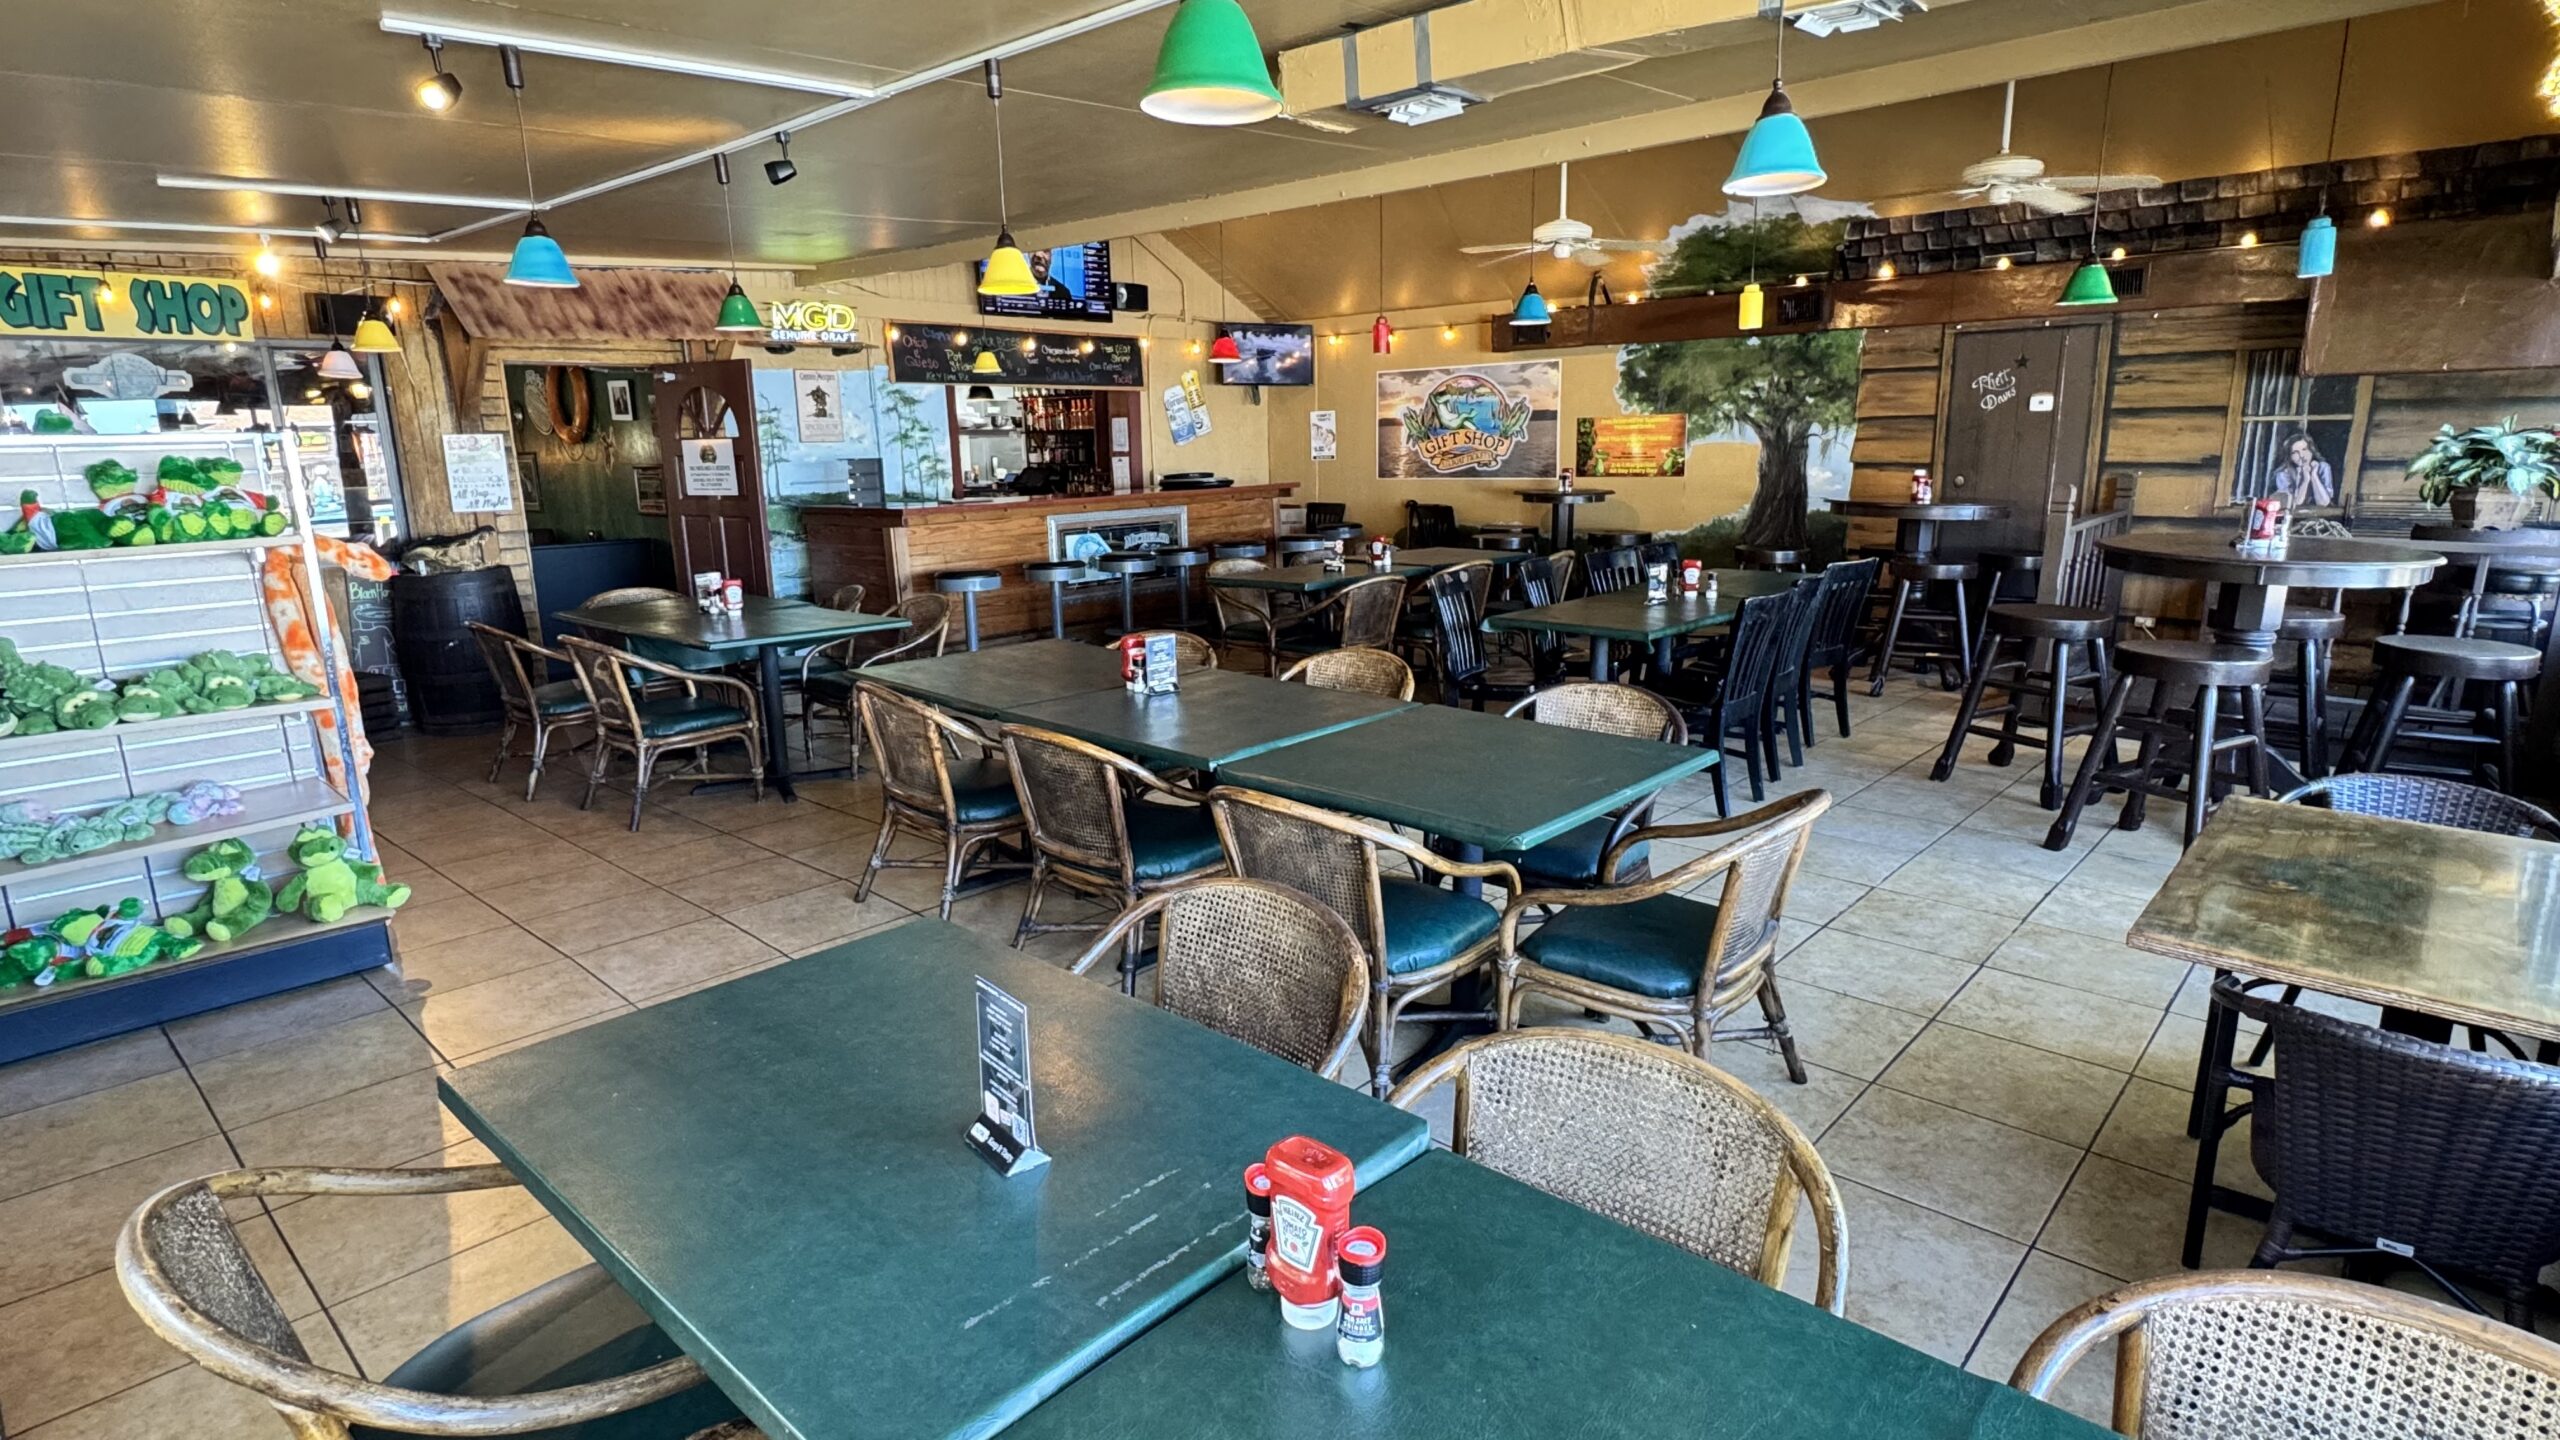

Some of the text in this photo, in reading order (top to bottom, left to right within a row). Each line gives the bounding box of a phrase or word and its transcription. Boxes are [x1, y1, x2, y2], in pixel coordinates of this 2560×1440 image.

[0, 271, 249, 337] GIFT SHOP
[771, 300, 856, 332] MGD
[820, 331, 857, 343] DRAFT
[1425, 430, 1505, 454] GIFT SHOP
[1283, 1206, 1305, 1223] HEINZ
[1283, 1216, 1307, 1235] TOMATO
